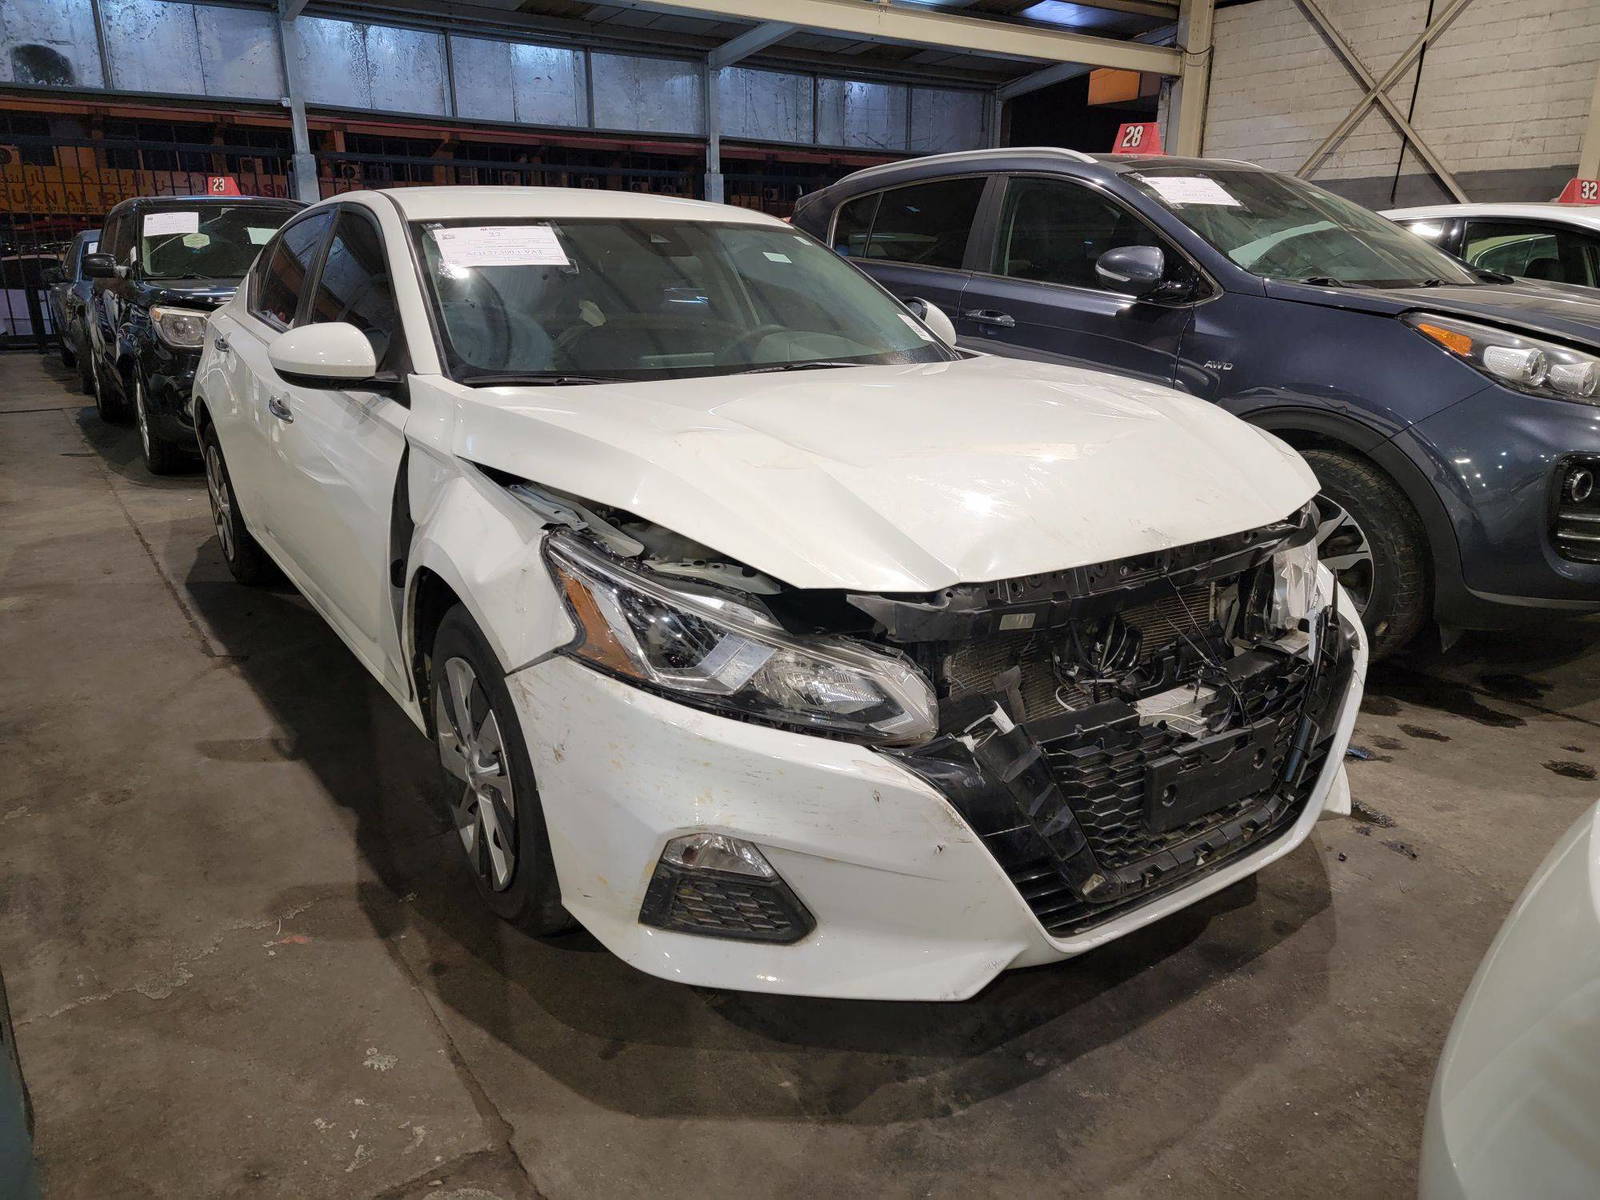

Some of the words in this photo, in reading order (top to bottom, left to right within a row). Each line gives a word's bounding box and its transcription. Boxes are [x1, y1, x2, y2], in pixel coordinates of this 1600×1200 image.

[1122, 125, 1144, 148] 28
[213, 178, 225, 192] 23
[1581, 181, 1598, 200] 32
[1203, 360, 1234, 371] AWD
